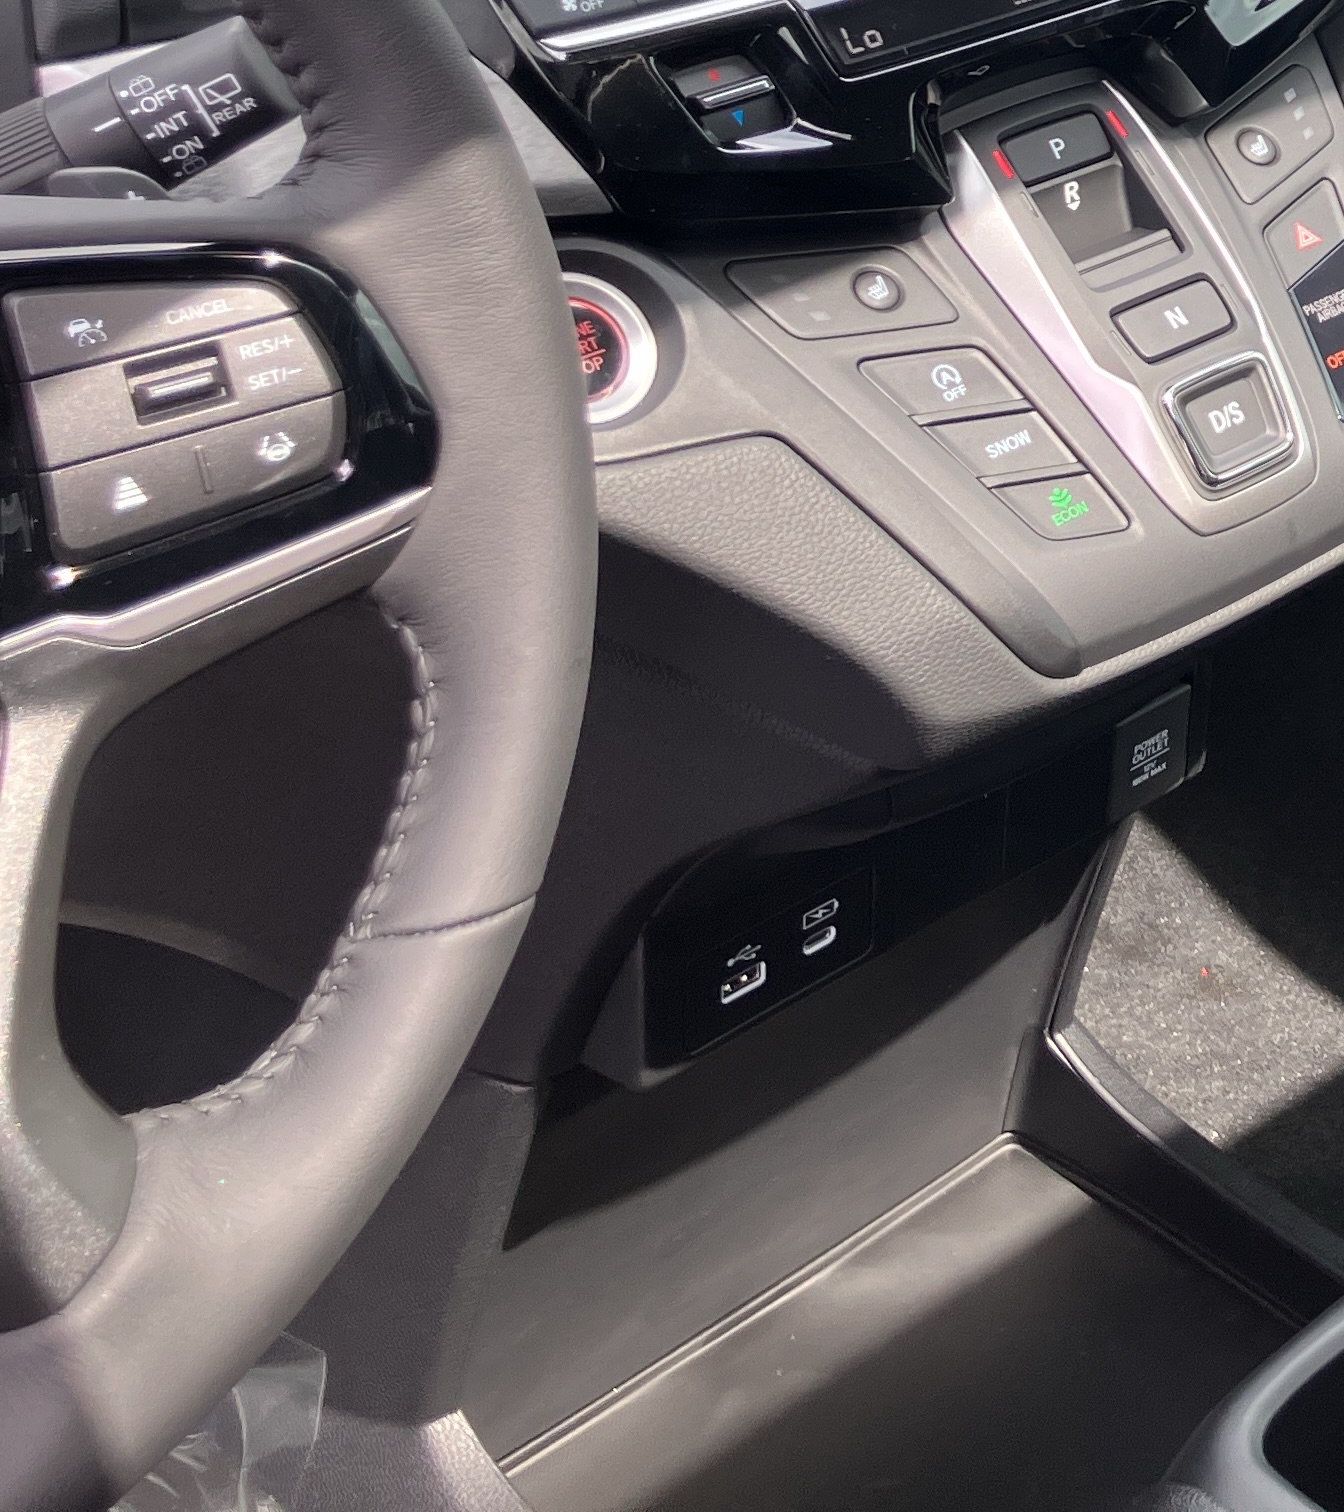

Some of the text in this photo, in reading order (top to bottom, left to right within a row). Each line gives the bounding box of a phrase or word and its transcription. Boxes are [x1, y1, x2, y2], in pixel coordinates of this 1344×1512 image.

[140, 83, 179, 113] OFF
[211, 96, 258, 125] REAR
[154, 110, 190, 138] INT
[172, 135, 205, 160] ON
[1048, 137, 1066, 160] P
[1063, 180, 1081, 204] R
[166, 298, 231, 325] CANCEL
[1164, 306, 1190, 329] N
[240, 334, 297, 361] RES/+
[942, 384, 967, 402] OFF
[1208, 400, 1245, 434] D/S
[985, 429, 1033, 459] SNOW
[1051, 500, 1090, 527] ECON
[1132, 737, 1169, 764] OUTLET
[1134, 729, 1169, 755] POWER
